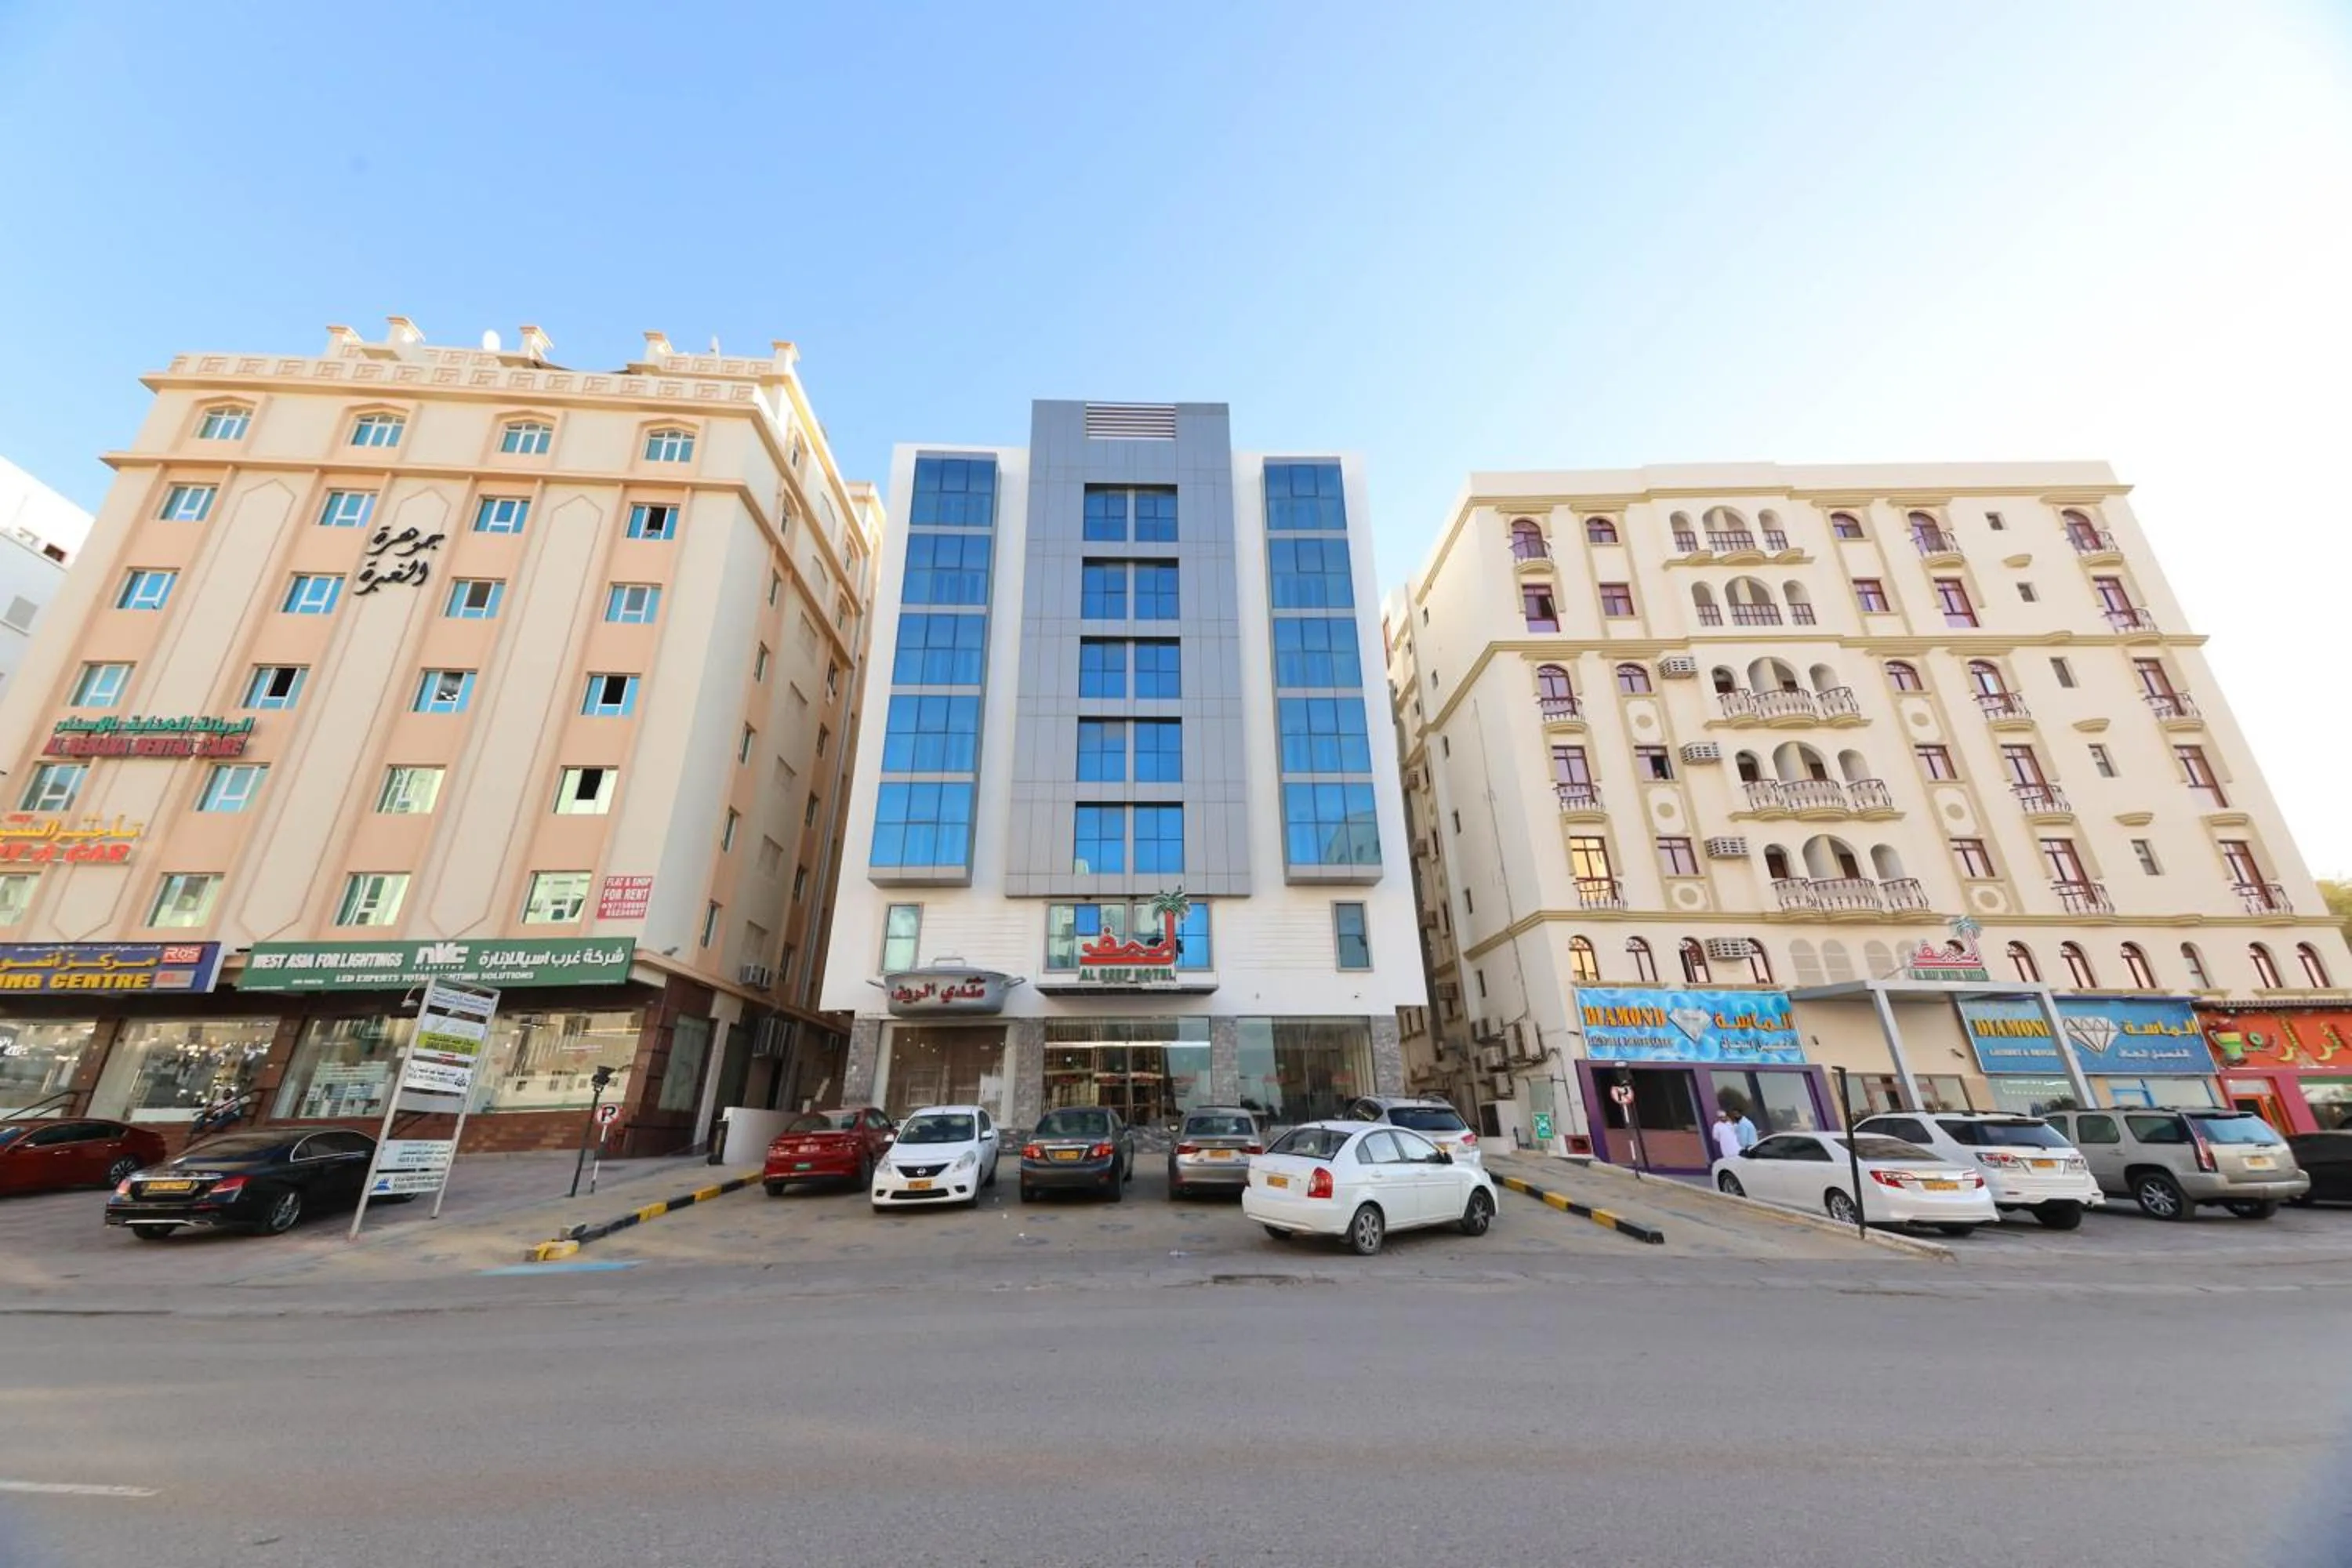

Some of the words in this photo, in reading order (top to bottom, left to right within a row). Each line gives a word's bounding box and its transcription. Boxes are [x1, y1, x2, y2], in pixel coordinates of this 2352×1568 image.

[252, 954, 287, 968] WEST
[285, 954, 314, 967] ASIA
[49, 973, 151, 989] CENTRE
[481, 971, 535, 981] SOLUTIONS
[1080, 968, 1095, 980] AL
[1135, 968, 1174, 980] HOTEL
[1582, 1006, 1668, 1027] DIAMOND
[1973, 1018, 2052, 1037] DIAMON
[2123, 1020, 2198, 1038] الماسة
